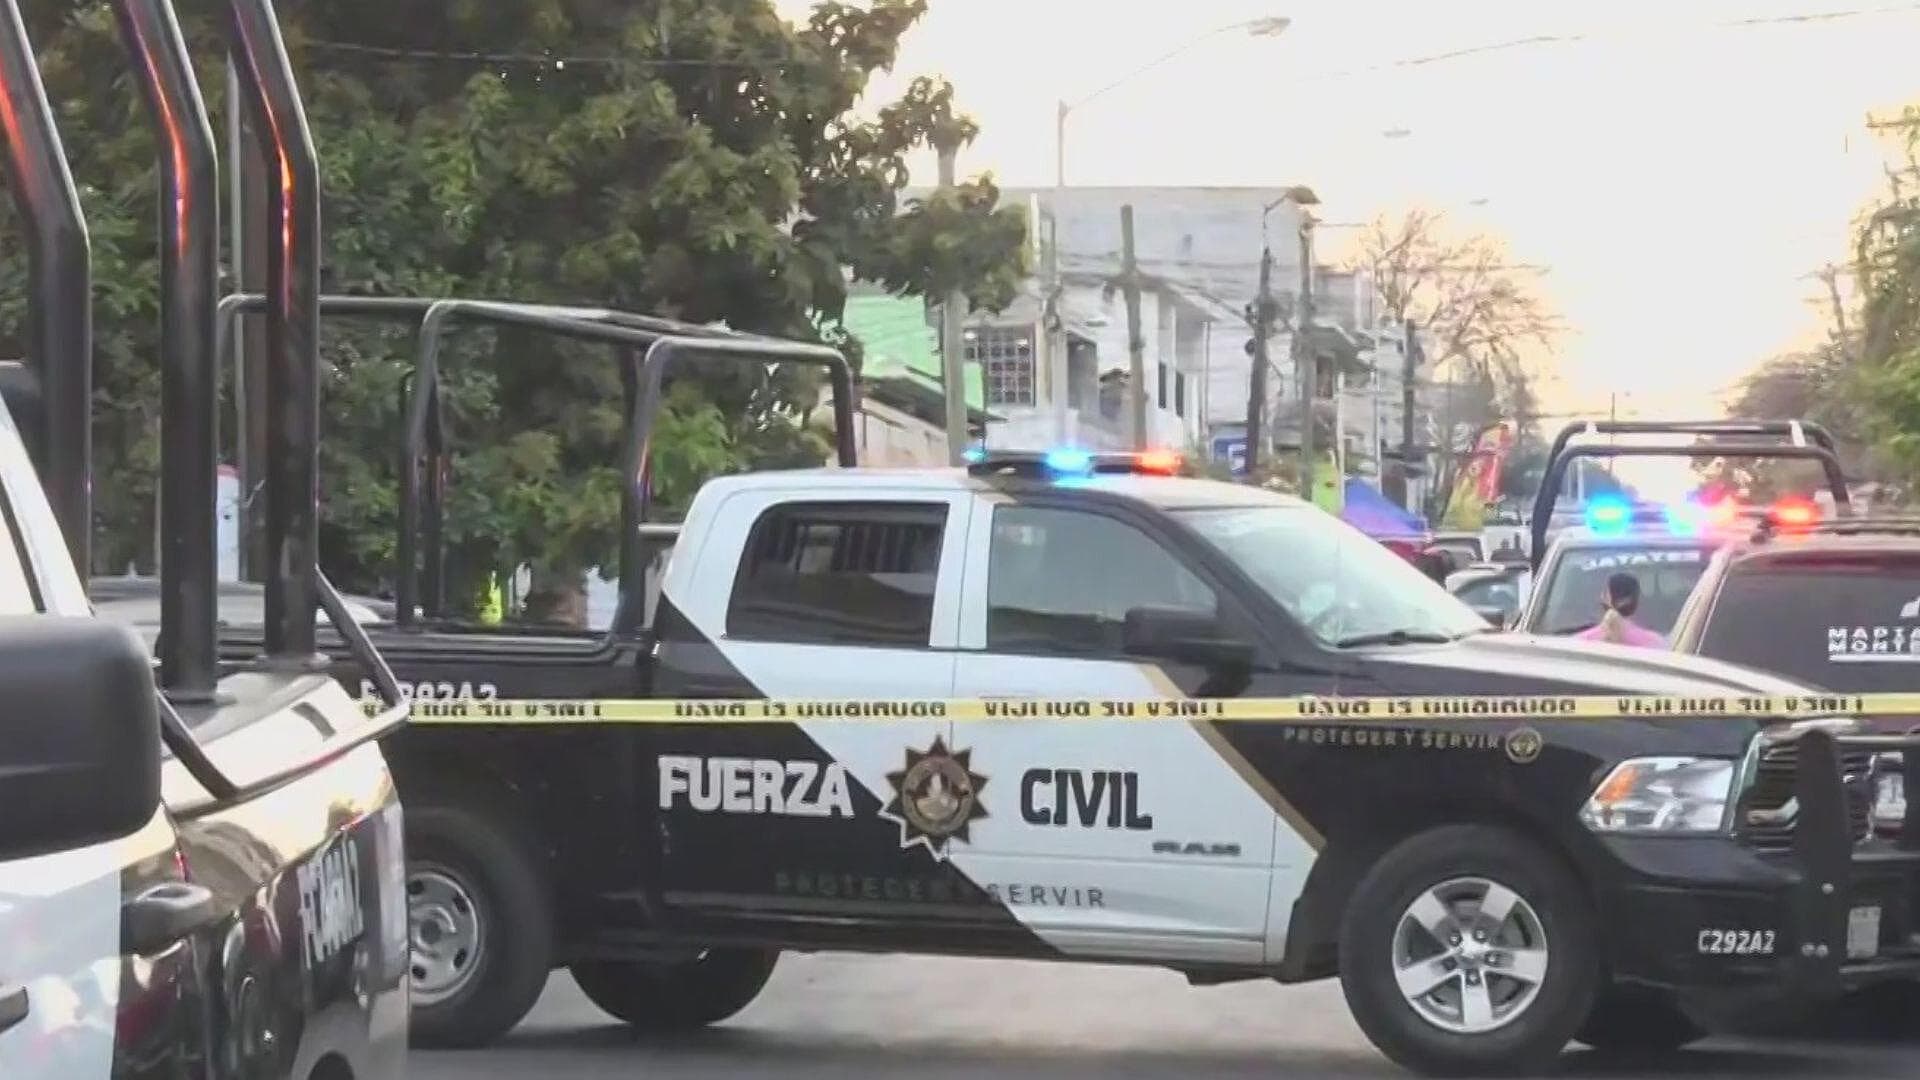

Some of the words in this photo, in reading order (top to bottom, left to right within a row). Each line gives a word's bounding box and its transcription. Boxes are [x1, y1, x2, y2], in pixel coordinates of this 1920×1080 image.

[1284, 727, 1396, 746] PROTEGER
[1403, 730, 1414, 746] Y
[1421, 731, 1499, 749] SERVIR
[657, 754, 854, 818] FUERZA
[1019, 767, 1153, 830] CIVIL
[986, 882, 1106, 908] SERVIR
[1698, 930, 1775, 954] C292A2
